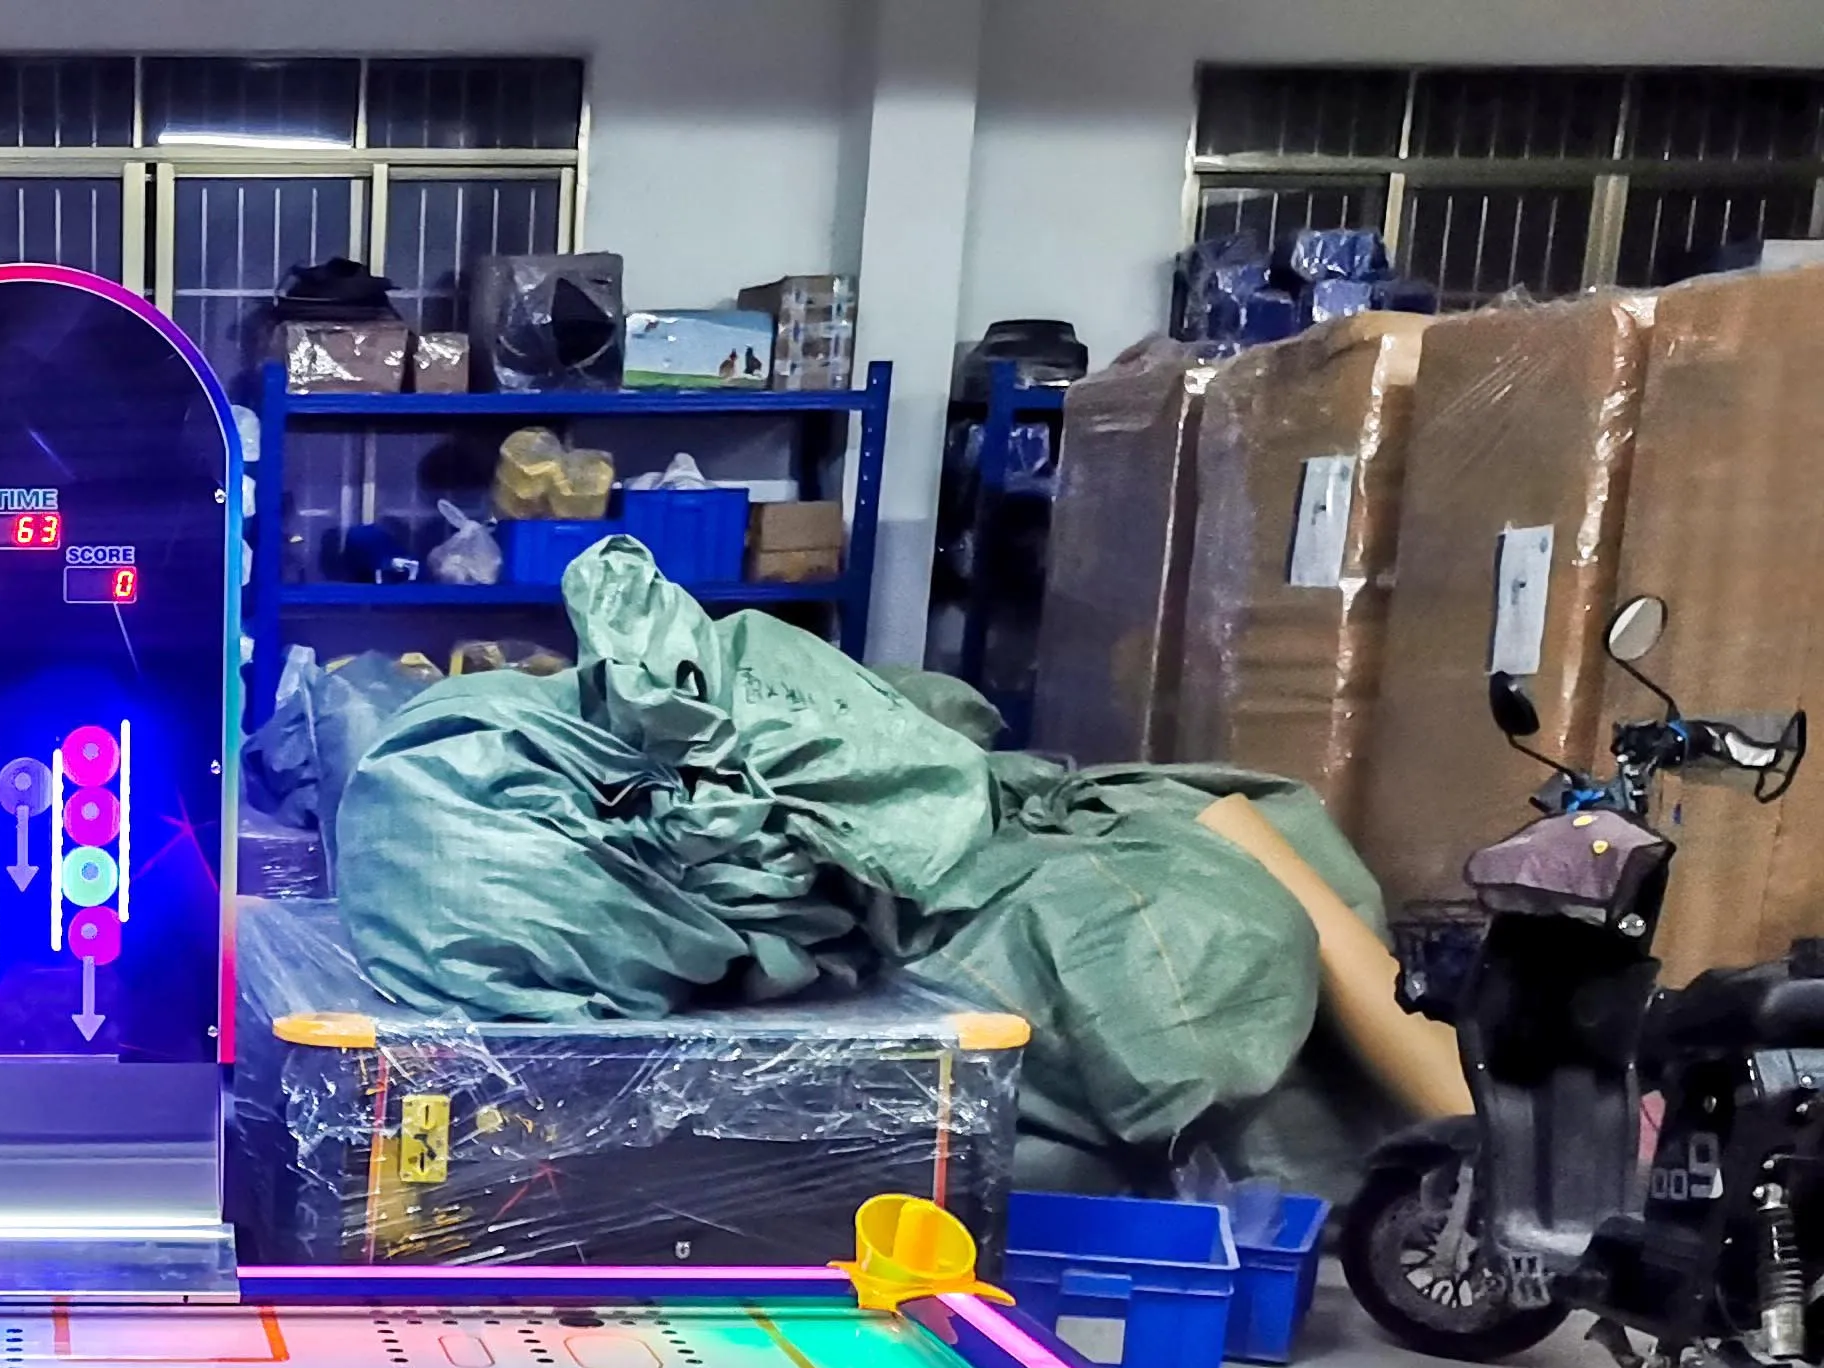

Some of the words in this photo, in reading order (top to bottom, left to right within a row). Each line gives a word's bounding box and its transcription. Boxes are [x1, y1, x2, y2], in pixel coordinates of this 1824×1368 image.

[16, 516, 58, 543] 63
[66, 546, 135, 564] SCORE
[115, 570, 135, 598] 0
